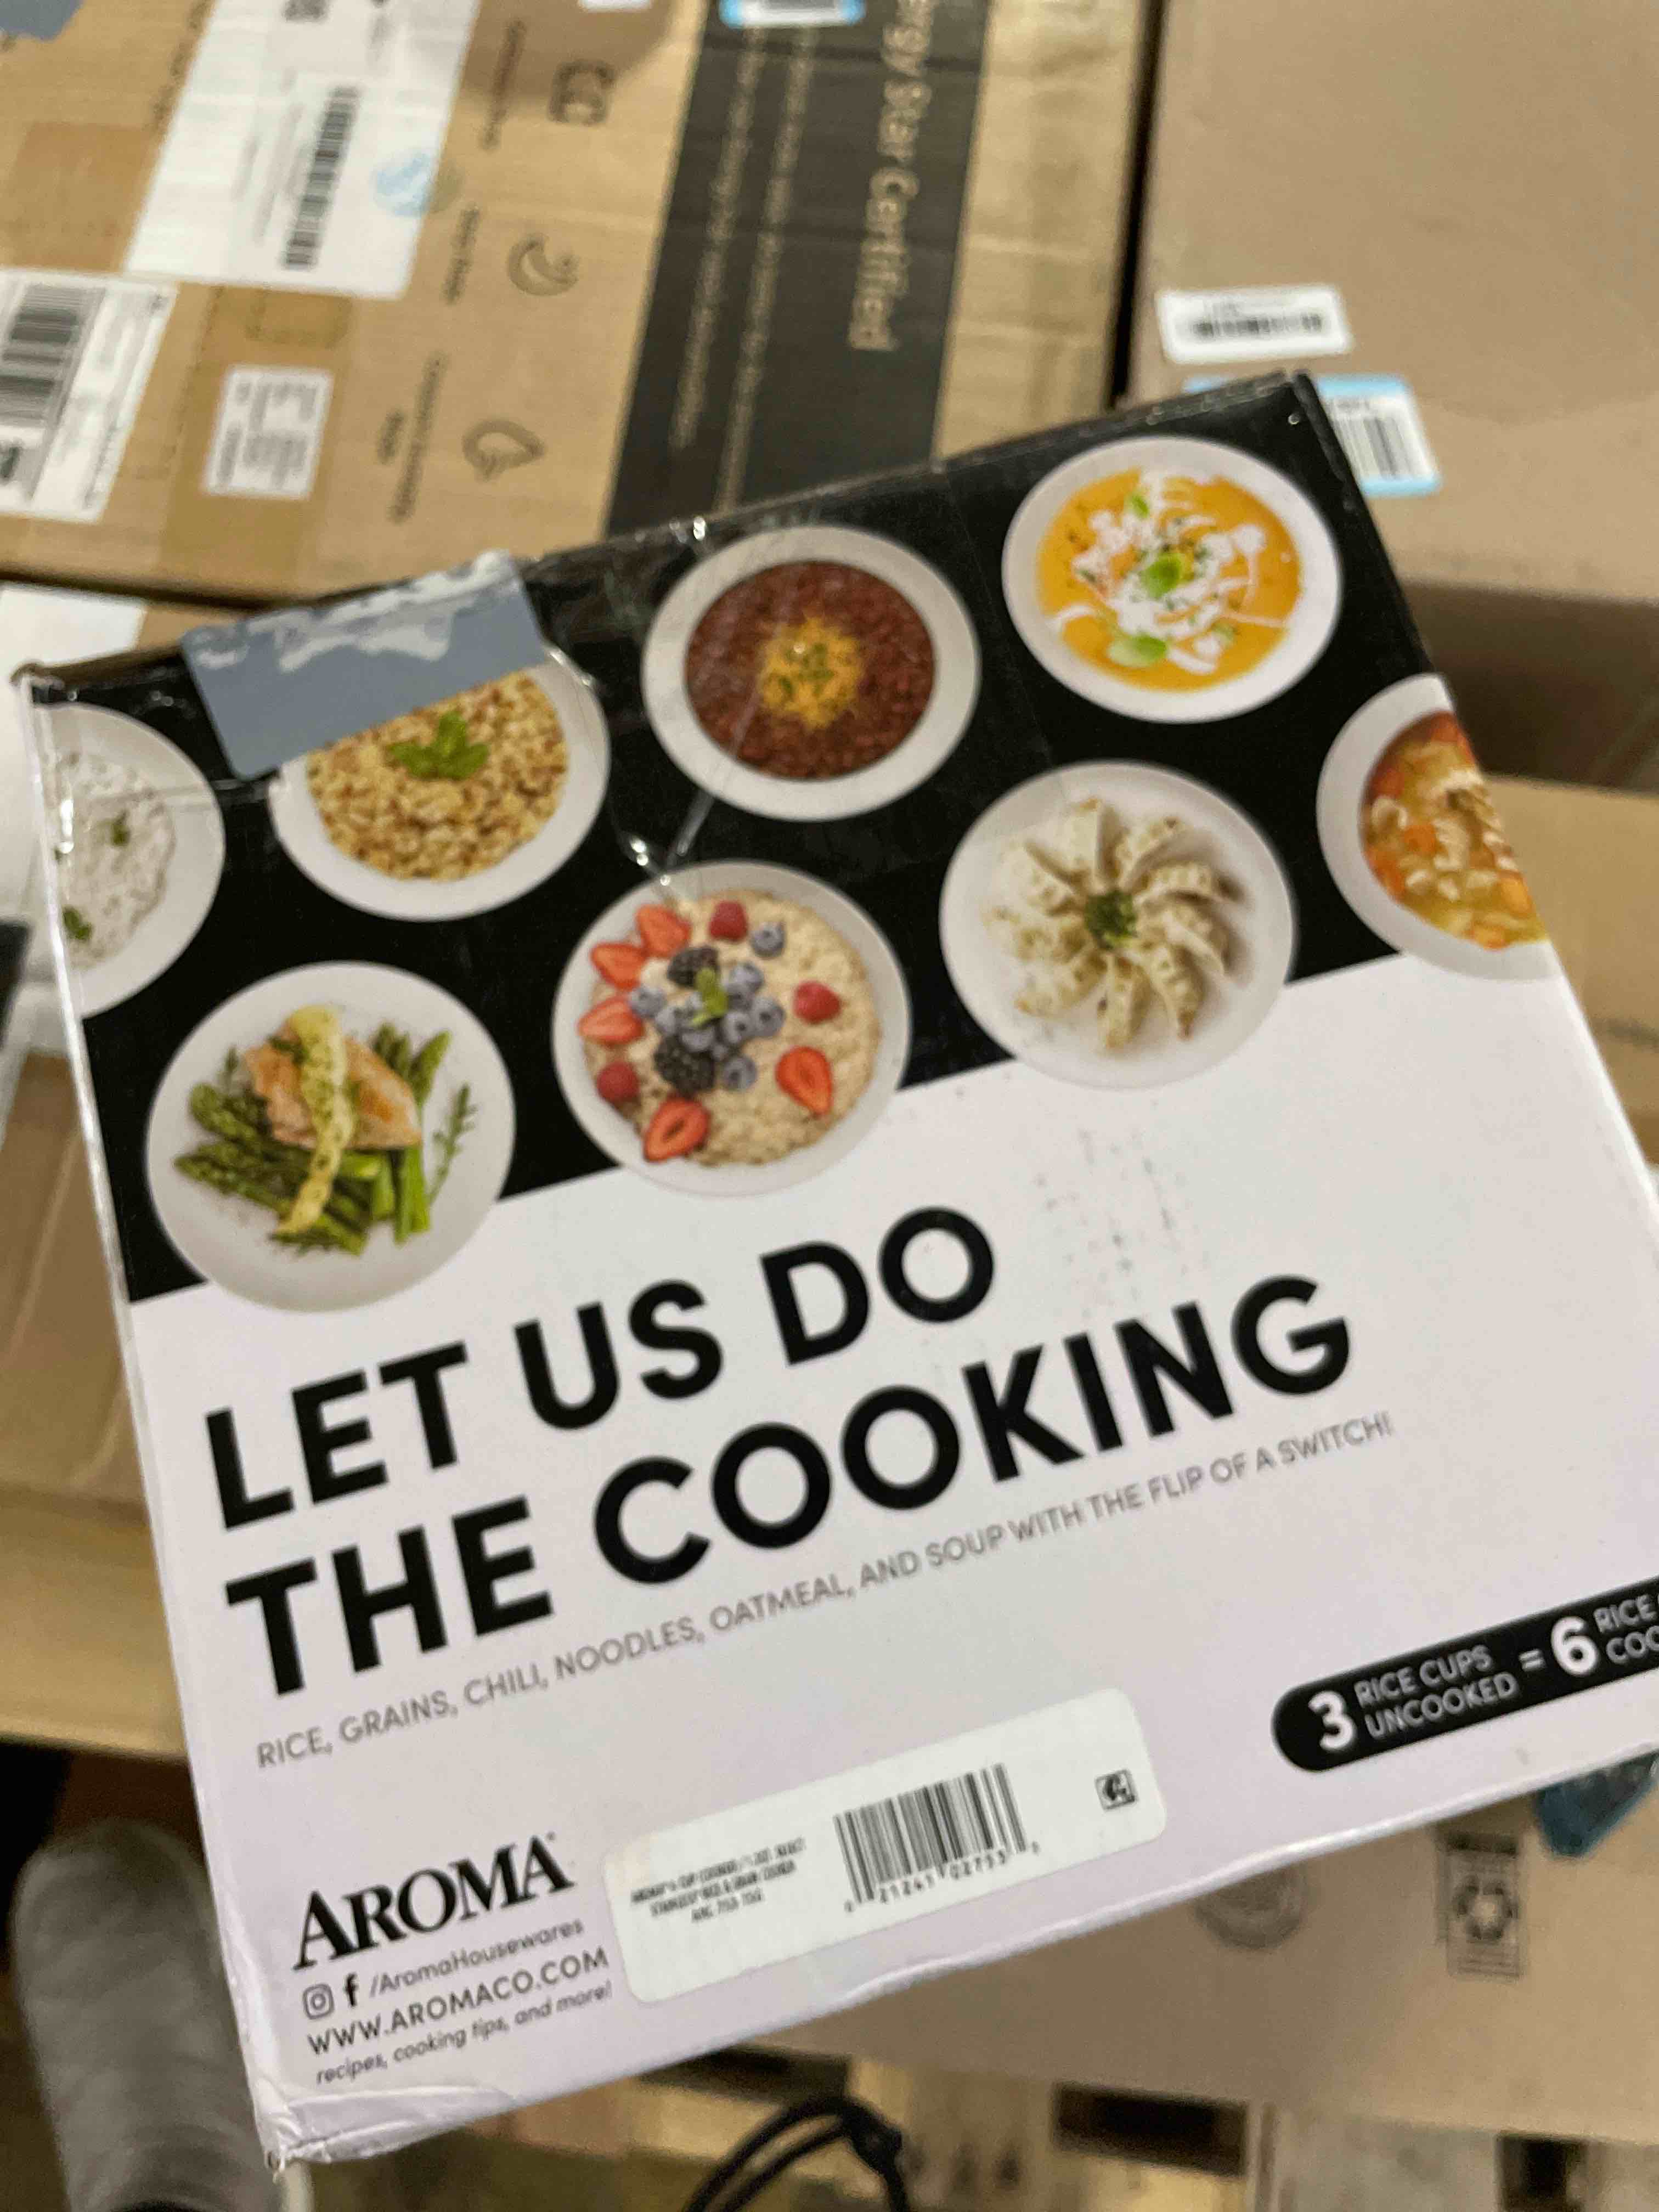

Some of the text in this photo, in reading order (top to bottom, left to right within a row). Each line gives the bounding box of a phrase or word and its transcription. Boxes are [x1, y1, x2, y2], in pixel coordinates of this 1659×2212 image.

[877, 81, 932, 159] Star
[846, 166, 919, 351] Certified
[206, 1206, 995, 1531] LET US DO
[224, 1275, 1350, 1696] THE COOKING
[257, 1412, 1392, 1768] RICE, GRAINS, CHILI, NOODLES, OATMEAL, AND SOUP WITH THE FLIP OF A SWITCH!
[1593, 1594, 1657, 1633] RICE
[1354, 1645, 1493, 1709] RICE CUPS
[1551, 1616, 1599, 1677] 6
[1308, 1690, 1357, 1752] 3
[1364, 1672, 1520, 1740] UNCOOKED
[291, 1834, 576, 1971] AROMA
[306, 1945, 610, 2055] WWW.AROMACO.COM
[317, 1978, 612, 2084] recipes, cooking tips, and more!
